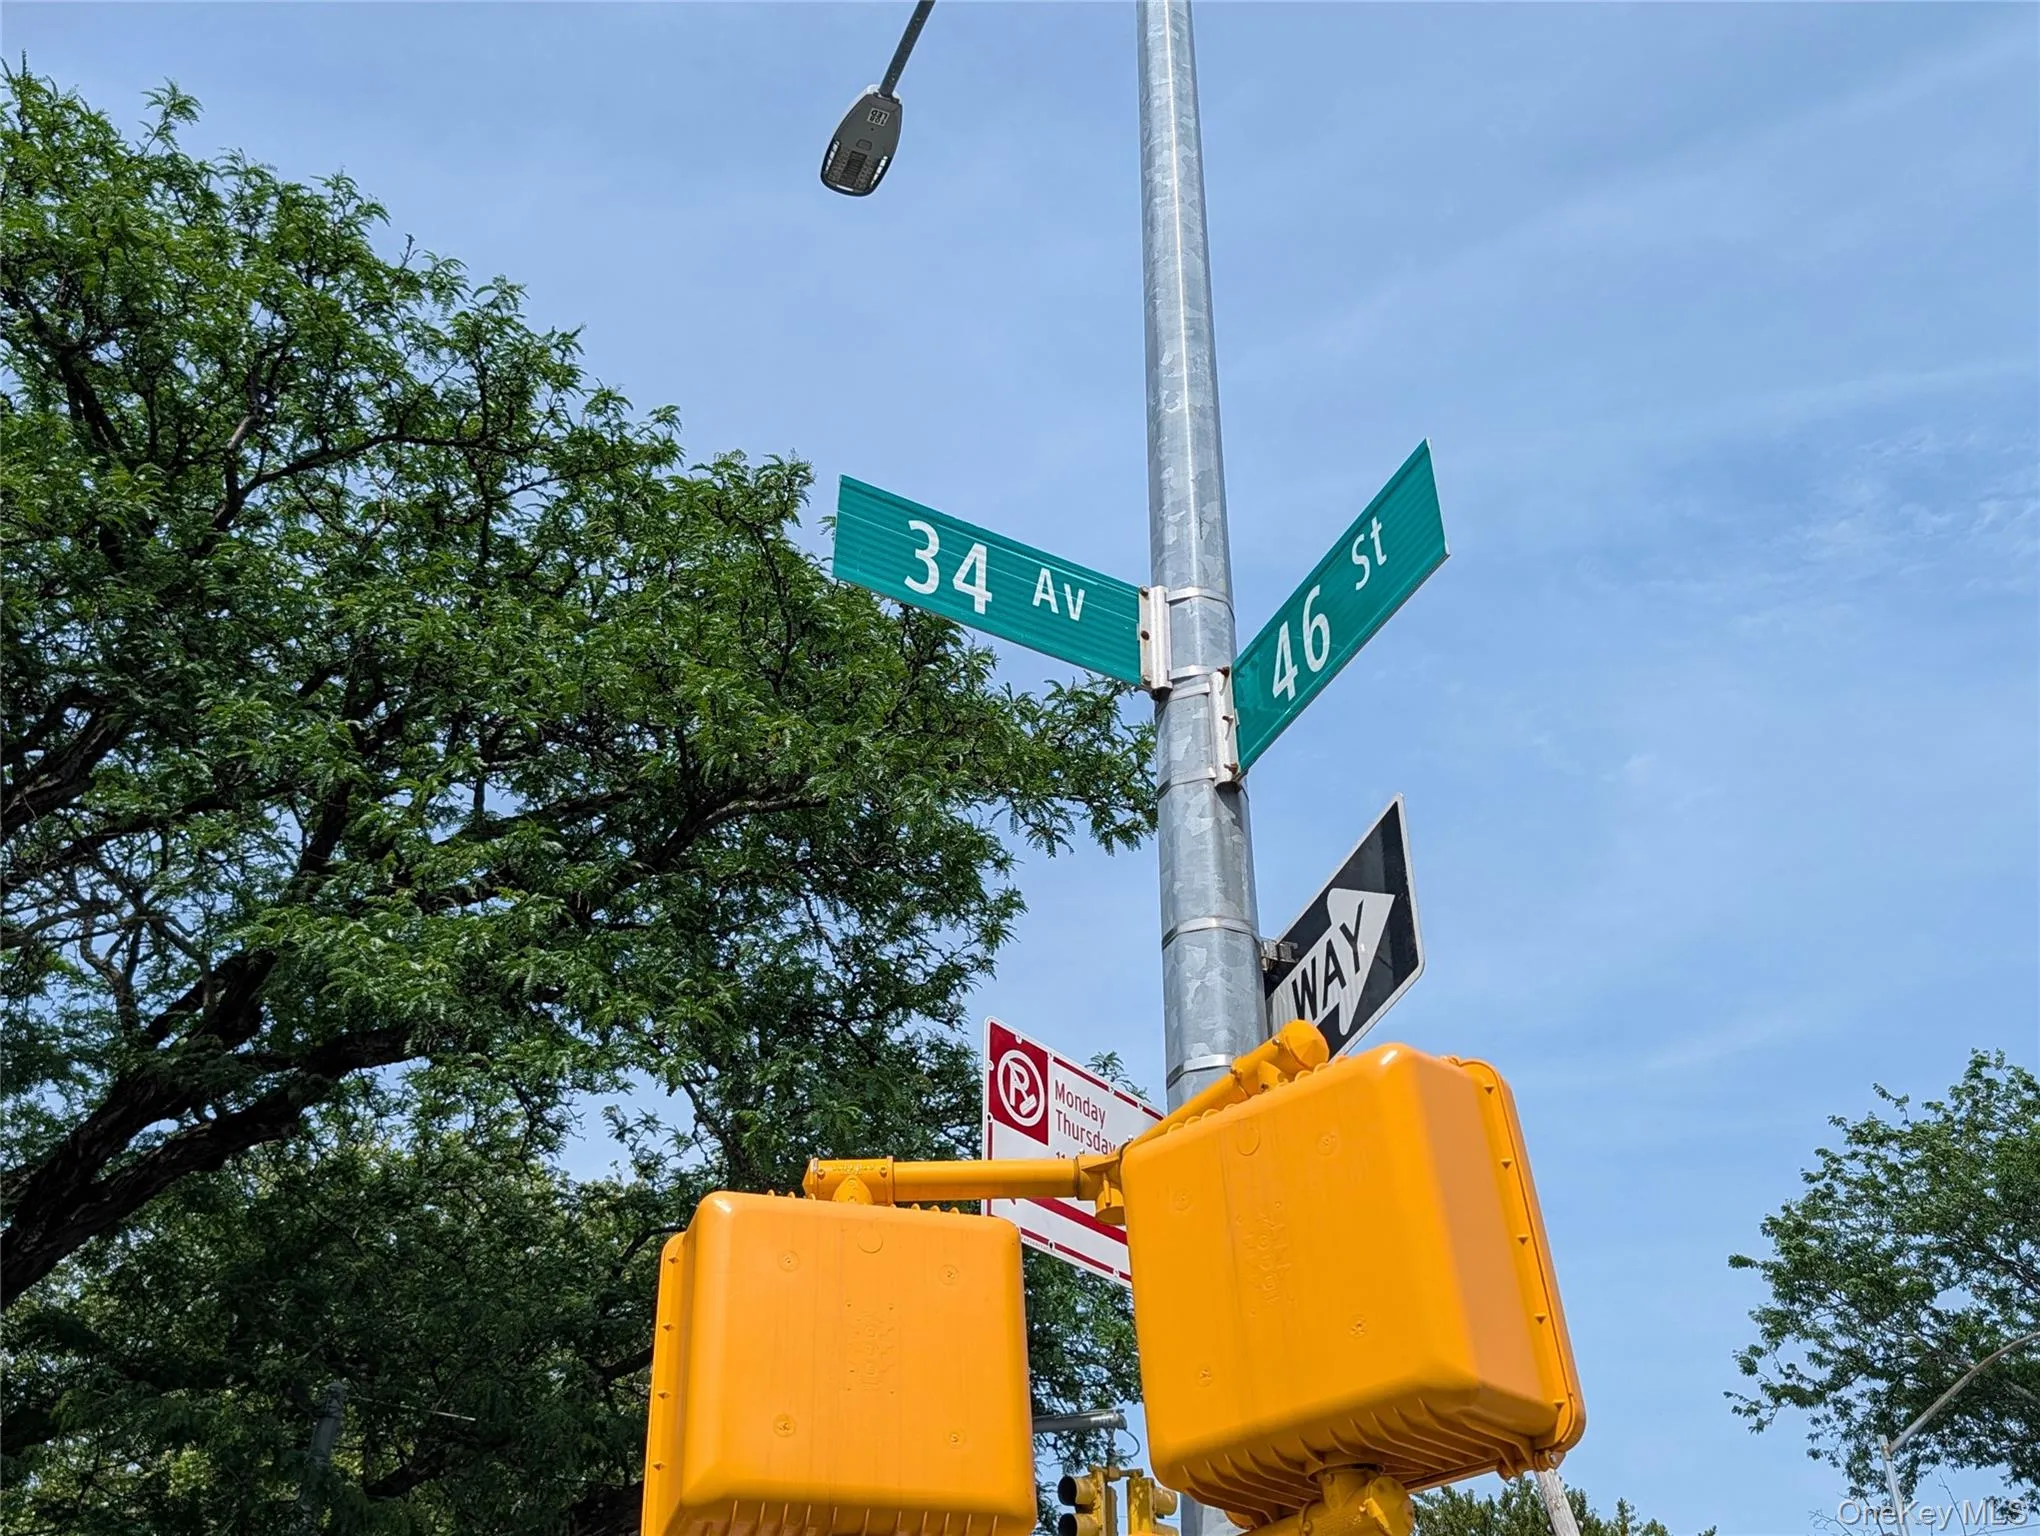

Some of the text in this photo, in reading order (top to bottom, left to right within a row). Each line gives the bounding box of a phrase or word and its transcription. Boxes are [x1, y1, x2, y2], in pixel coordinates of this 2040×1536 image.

[904, 520, 1085, 621] 34 Av
[1272, 516, 1388, 701] 46 St
[1291, 899, 1365, 1020] WAY
[1055, 1080, 1106, 1128] Monday
